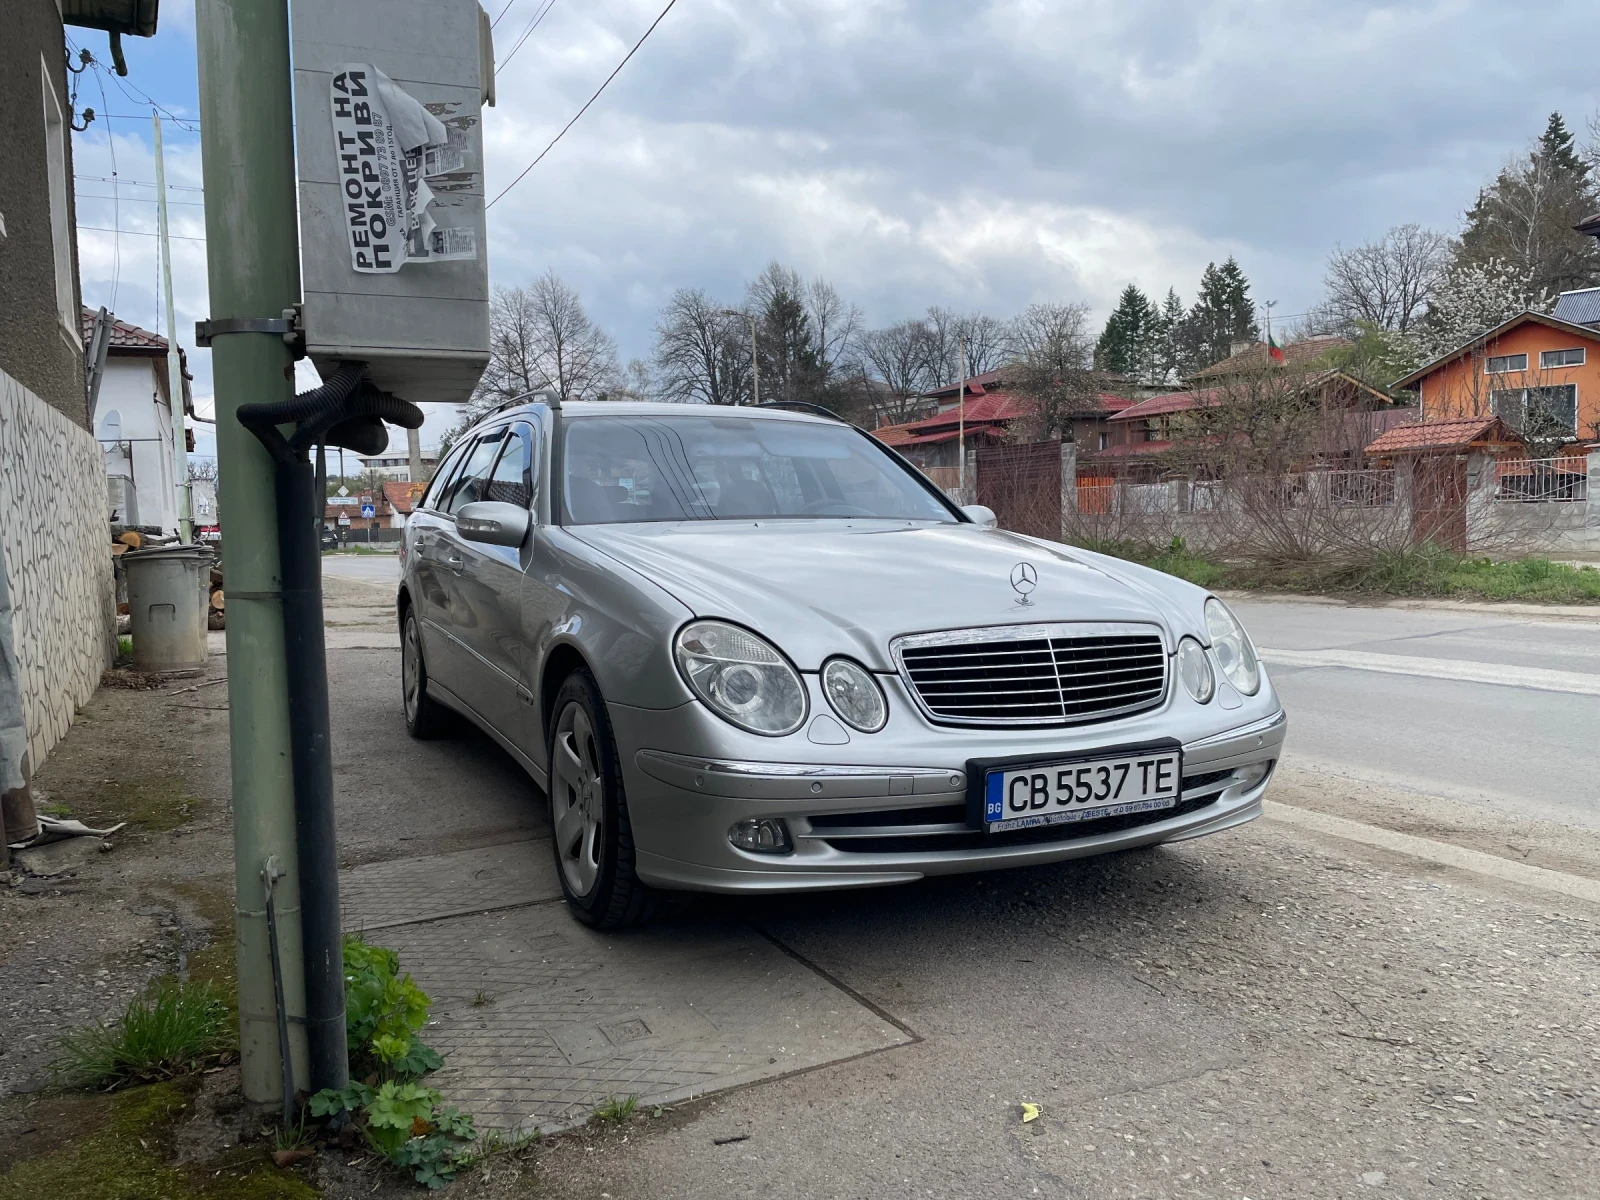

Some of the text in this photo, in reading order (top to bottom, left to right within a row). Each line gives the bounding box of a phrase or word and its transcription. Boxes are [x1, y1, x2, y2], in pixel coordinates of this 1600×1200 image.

[333, 71, 374, 269] РЕМОНТ НА
[349, 71, 393, 269] ПОКРИВИ
[372, 112, 396, 227] GSM: 0897 73 89 87
[391, 167, 398, 178] ОТ
[392, 178, 404, 218] ГАРАНЦИЯ
[988, 802, 1001, 815] BG
[1009, 758, 1174, 812] CB 5537 TE
